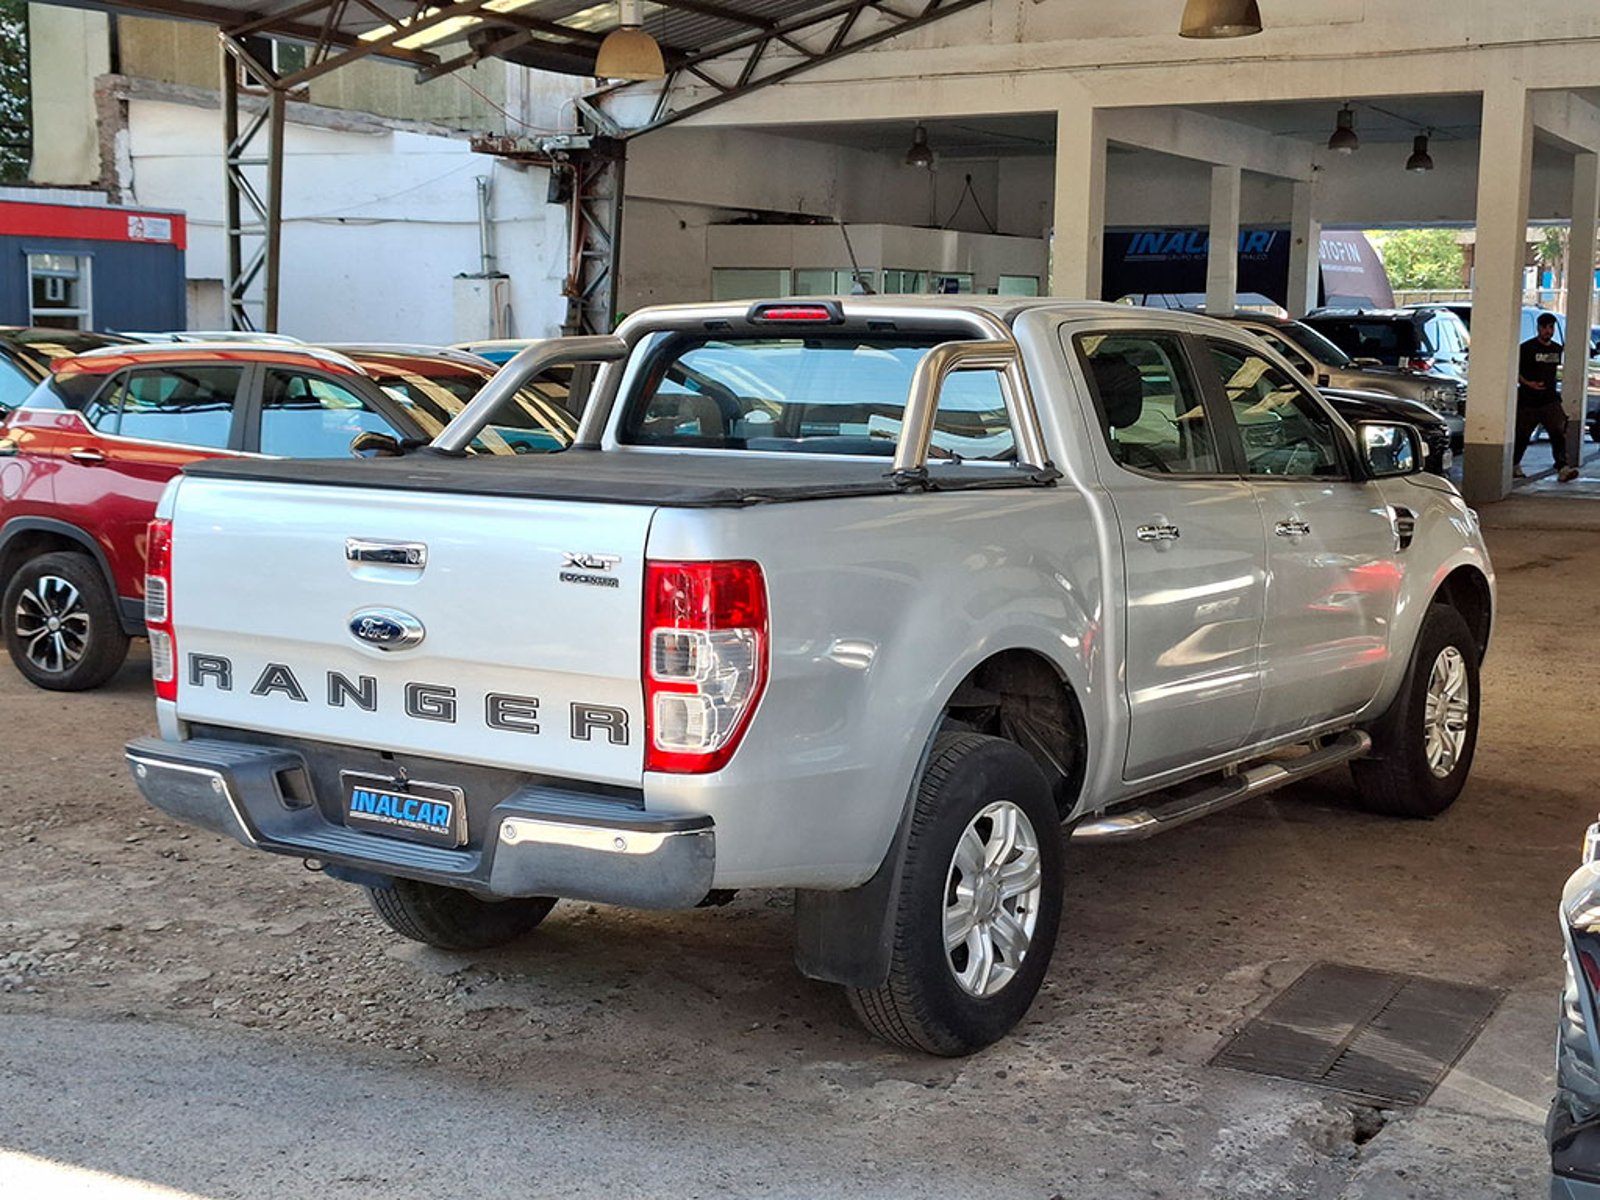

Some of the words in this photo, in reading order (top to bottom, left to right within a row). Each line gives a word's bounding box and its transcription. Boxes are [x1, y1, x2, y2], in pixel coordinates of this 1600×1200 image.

[1128, 231, 1269, 254] INALR
[561, 552, 622, 571] XLT
[359, 618, 391, 640] Ford
[187, 652, 630, 746] RANGER
[351, 790, 448, 827] INALCAR
